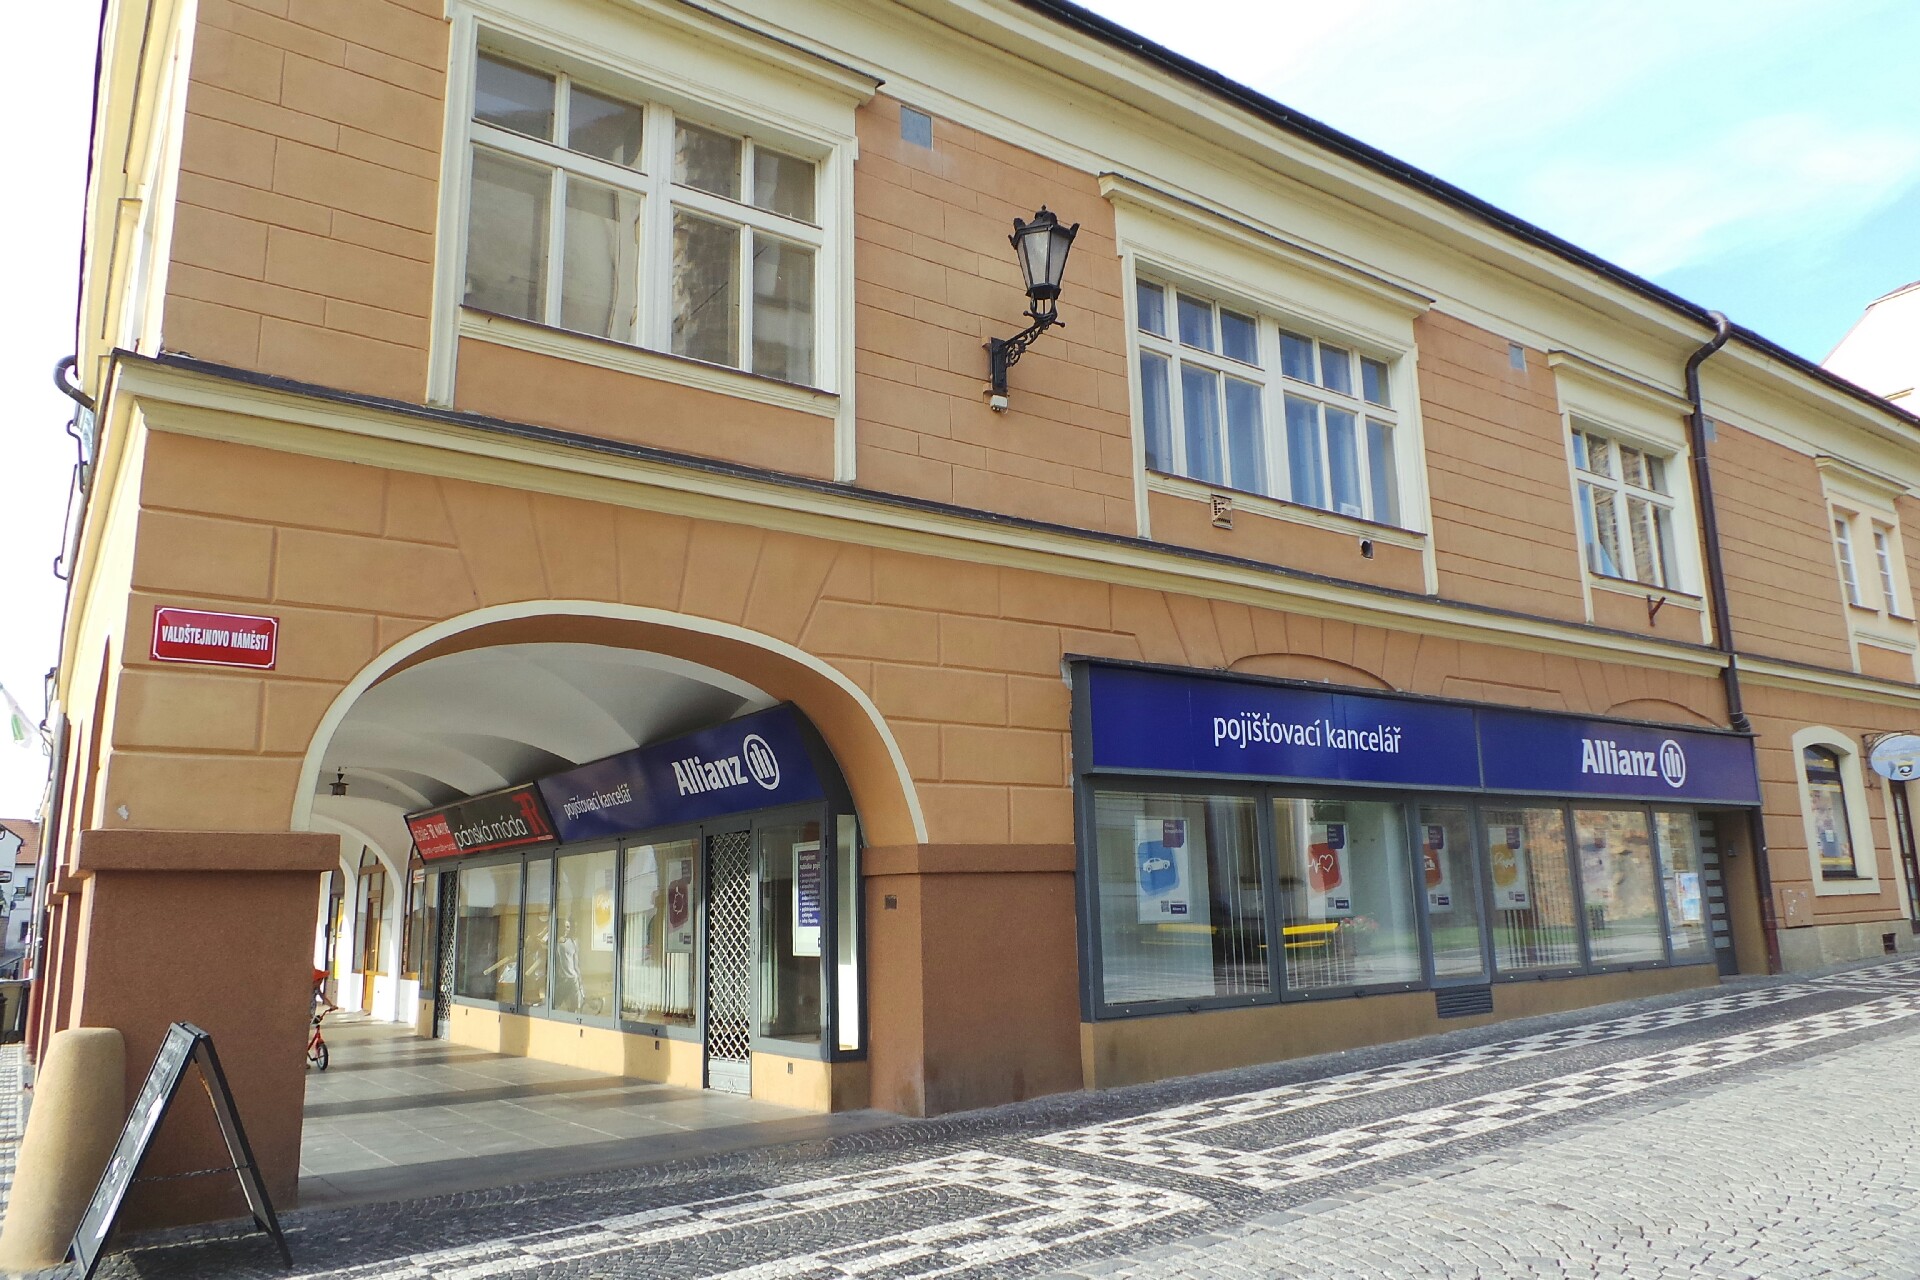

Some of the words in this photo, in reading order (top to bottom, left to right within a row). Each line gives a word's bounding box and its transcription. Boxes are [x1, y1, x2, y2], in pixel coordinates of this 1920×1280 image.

[162, 624, 229, 647] VALDŠTEJNOVO
[231, 629, 270, 651] NÁMĚSTÍ
[1213, 712, 1321, 749] pojišťovací
[1325, 719, 1402, 754] kancelář
[671, 755, 749, 796] Allianz
[1581, 739, 1658, 777] Allianz
[595, 782, 633, 809] kancelář
[454, 819, 493, 851] pánská
[492, 815, 528, 840] móda
